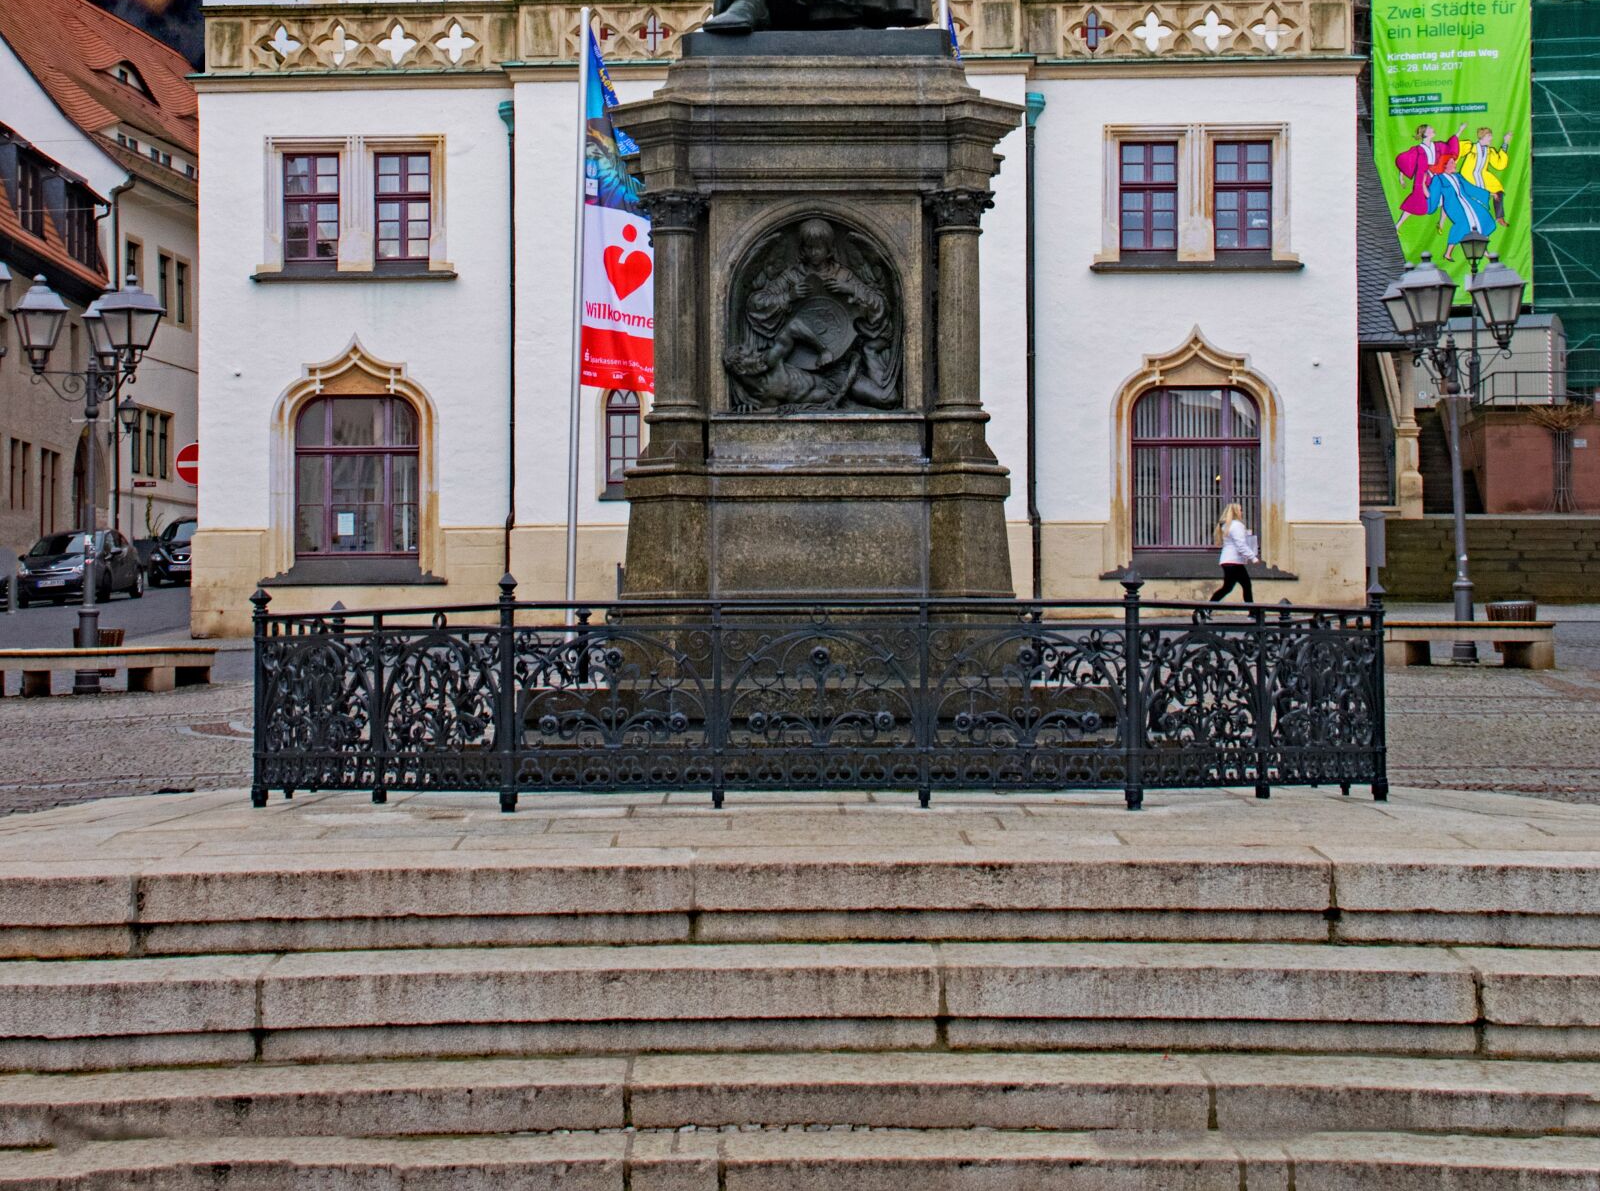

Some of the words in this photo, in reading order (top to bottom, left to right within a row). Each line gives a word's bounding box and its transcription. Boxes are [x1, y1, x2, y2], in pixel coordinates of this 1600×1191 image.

[1387, 5, 1425, 20] Zwei
[1431, 2, 1486, 17] Städte
[1491, 0, 1516, 14] für
[1387, 25, 1411, 40] ein
[1417, 22, 1485, 40] Halleluja
[1387, 51, 1438, 62] Kirchentag
[1440, 50, 1454, 59] auf
[1457, 49, 1476, 57] dem
[1478, 48, 1499, 59] Weg
[1422, 63, 1440, 72] Mai
[1442, 61, 1463, 71] 2017
[1390, 105, 1453, 114] Kirchentagsprogramm
